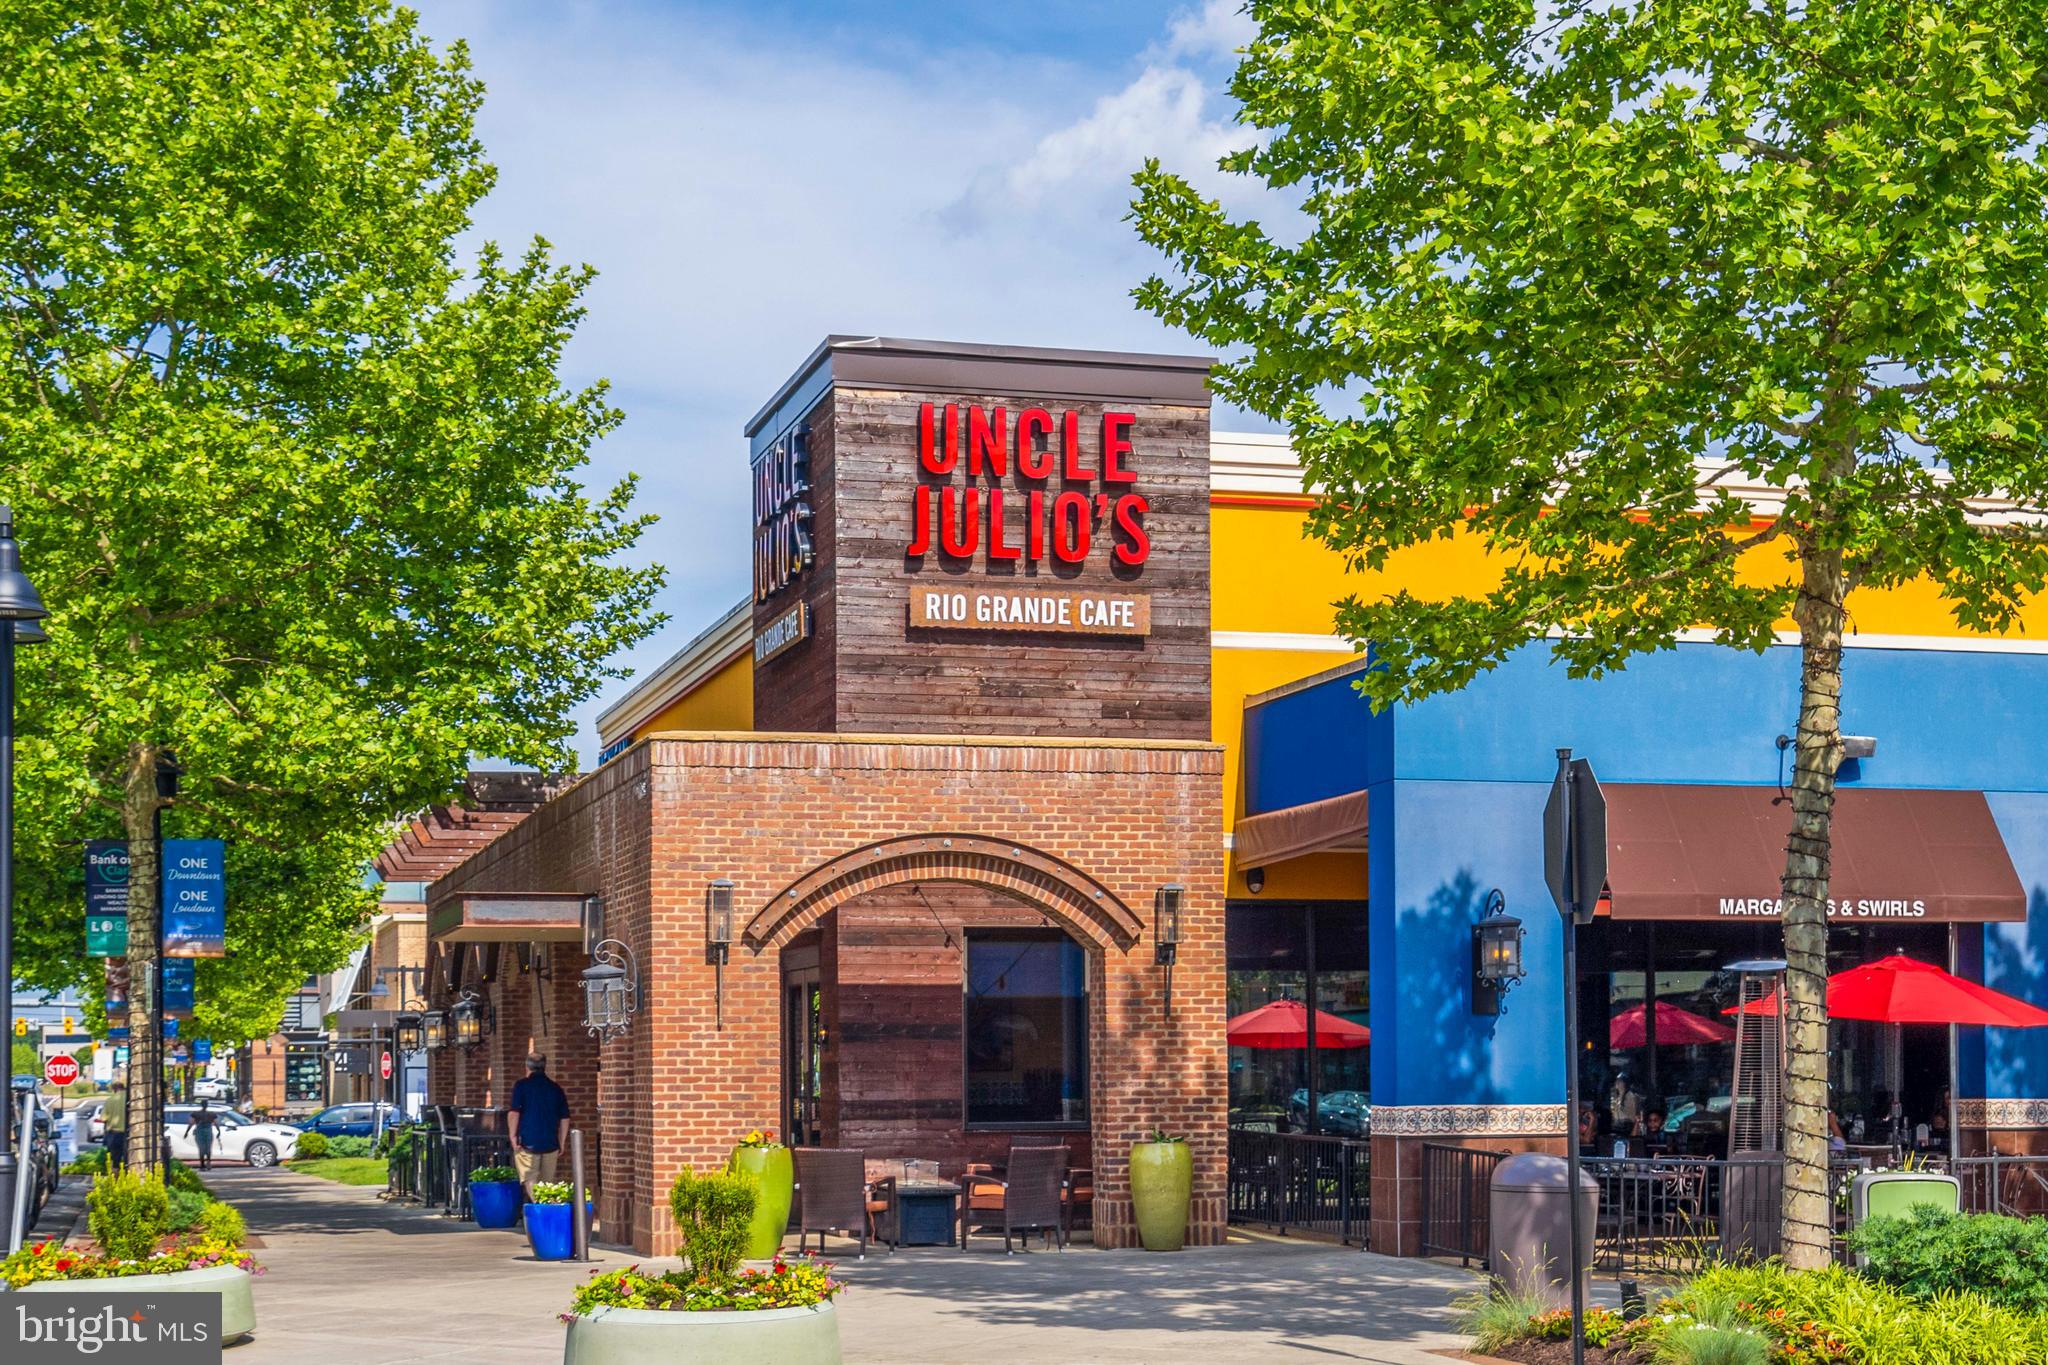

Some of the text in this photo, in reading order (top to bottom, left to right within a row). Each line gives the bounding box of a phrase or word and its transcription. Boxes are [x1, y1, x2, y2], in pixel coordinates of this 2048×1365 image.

[920, 402, 1138, 483] UNCLE
[755, 422, 804, 527] UNCLE
[907, 485, 1150, 565] JULIO'S
[925, 593, 1135, 628] RIO GRANDE CAFE
[90, 854, 118, 865] Bank
[179, 857, 209, 869] ONE
[168, 868, 221, 881] Downtown
[179, 890, 209, 901] ONE
[172, 902, 216, 913] Loudoun
[1719, 898, 1925, 917] MARGAS & SWIRLS
[47, 1064, 77, 1078] STOP
